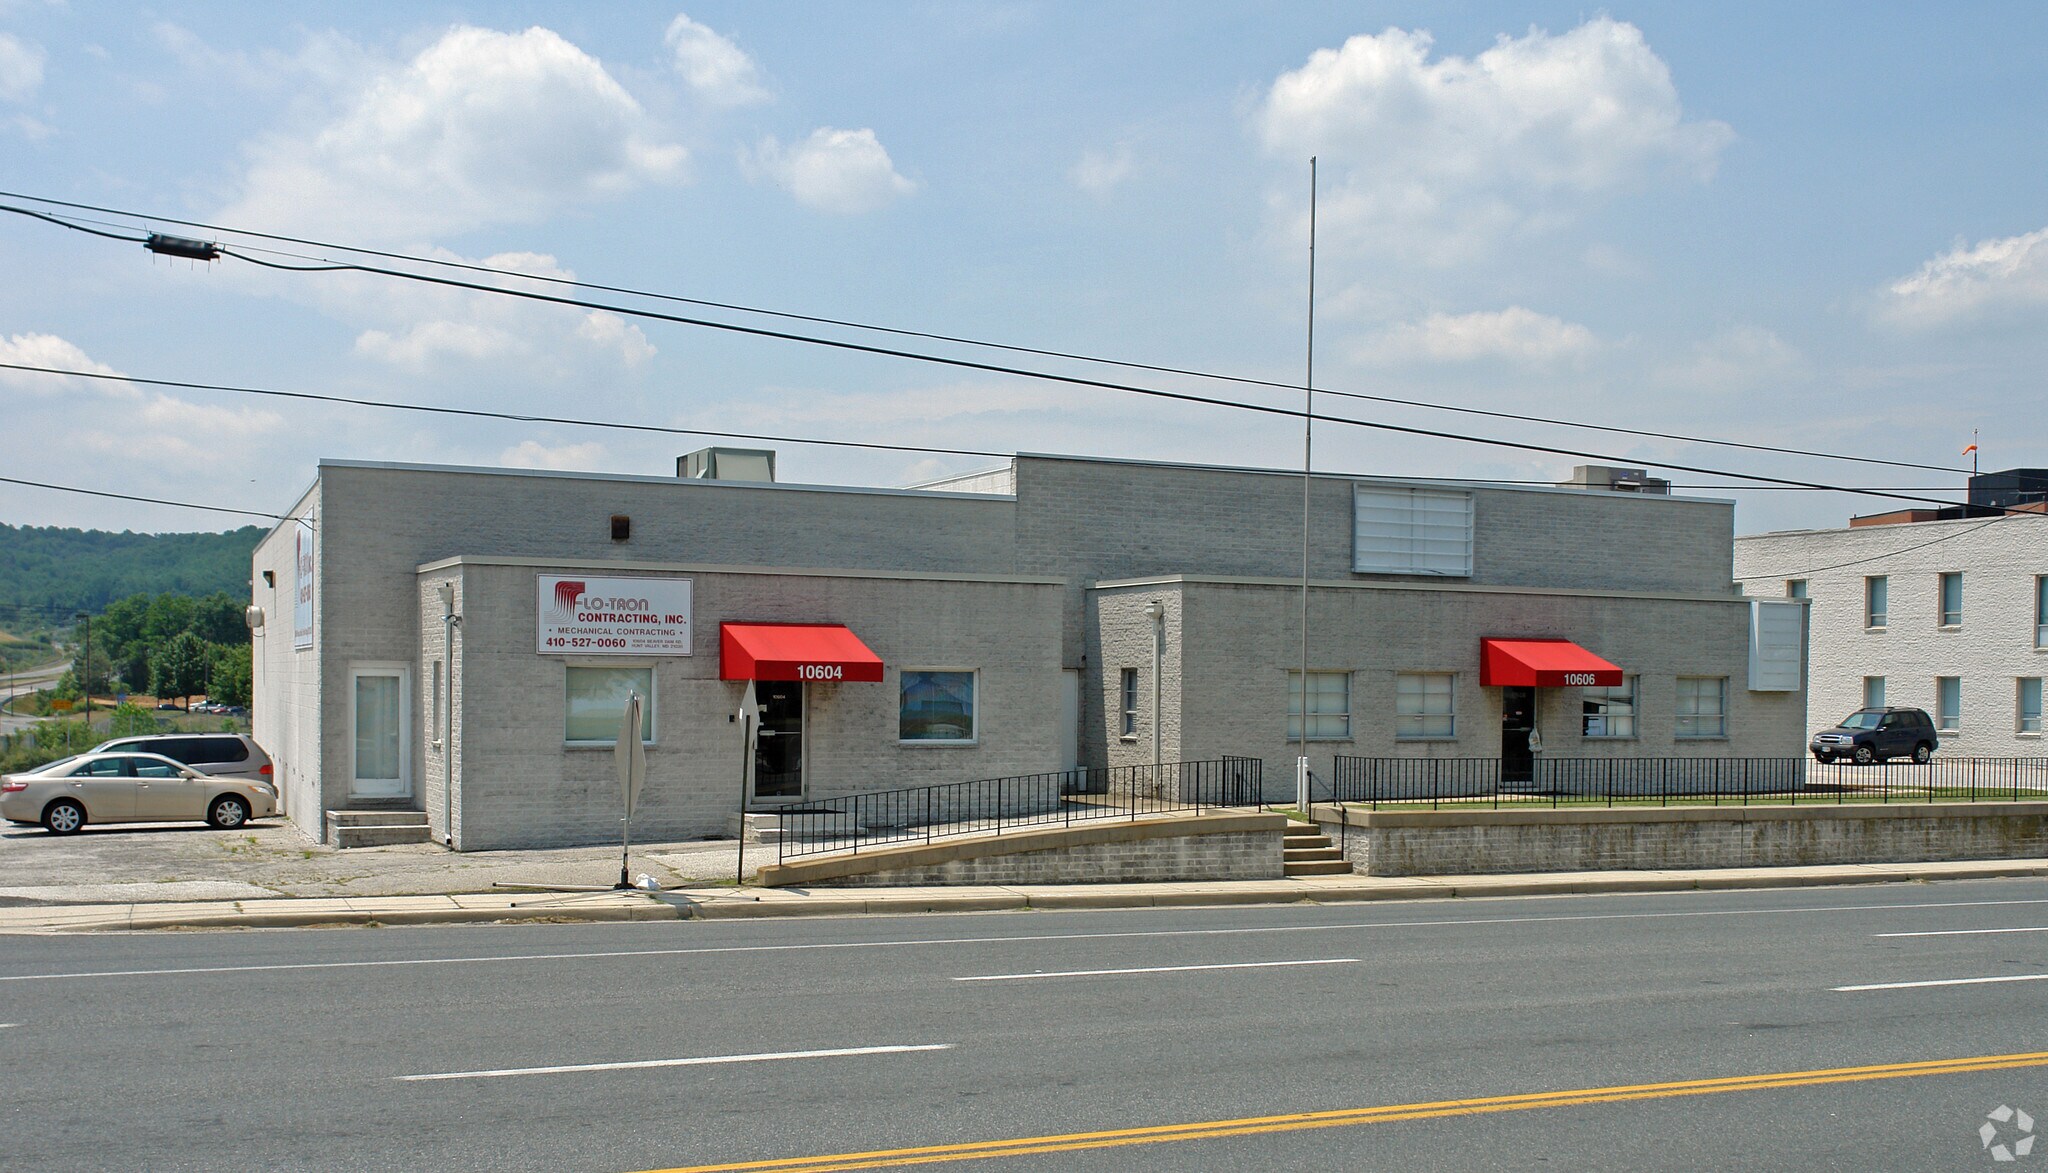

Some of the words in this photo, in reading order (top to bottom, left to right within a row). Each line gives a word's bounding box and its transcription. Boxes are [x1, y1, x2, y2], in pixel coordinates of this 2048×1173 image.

[578, 613, 661, 625] CONTRACTING,
[665, 614, 687, 625] INC.
[557, 627, 613, 635] MECHANICAL
[616, 628, 676, 636] CONTRACTING
[546, 637, 626, 648] 410-527-0060
[797, 665, 842, 679] 10604
[1564, 673, 1595, 685] 10606
